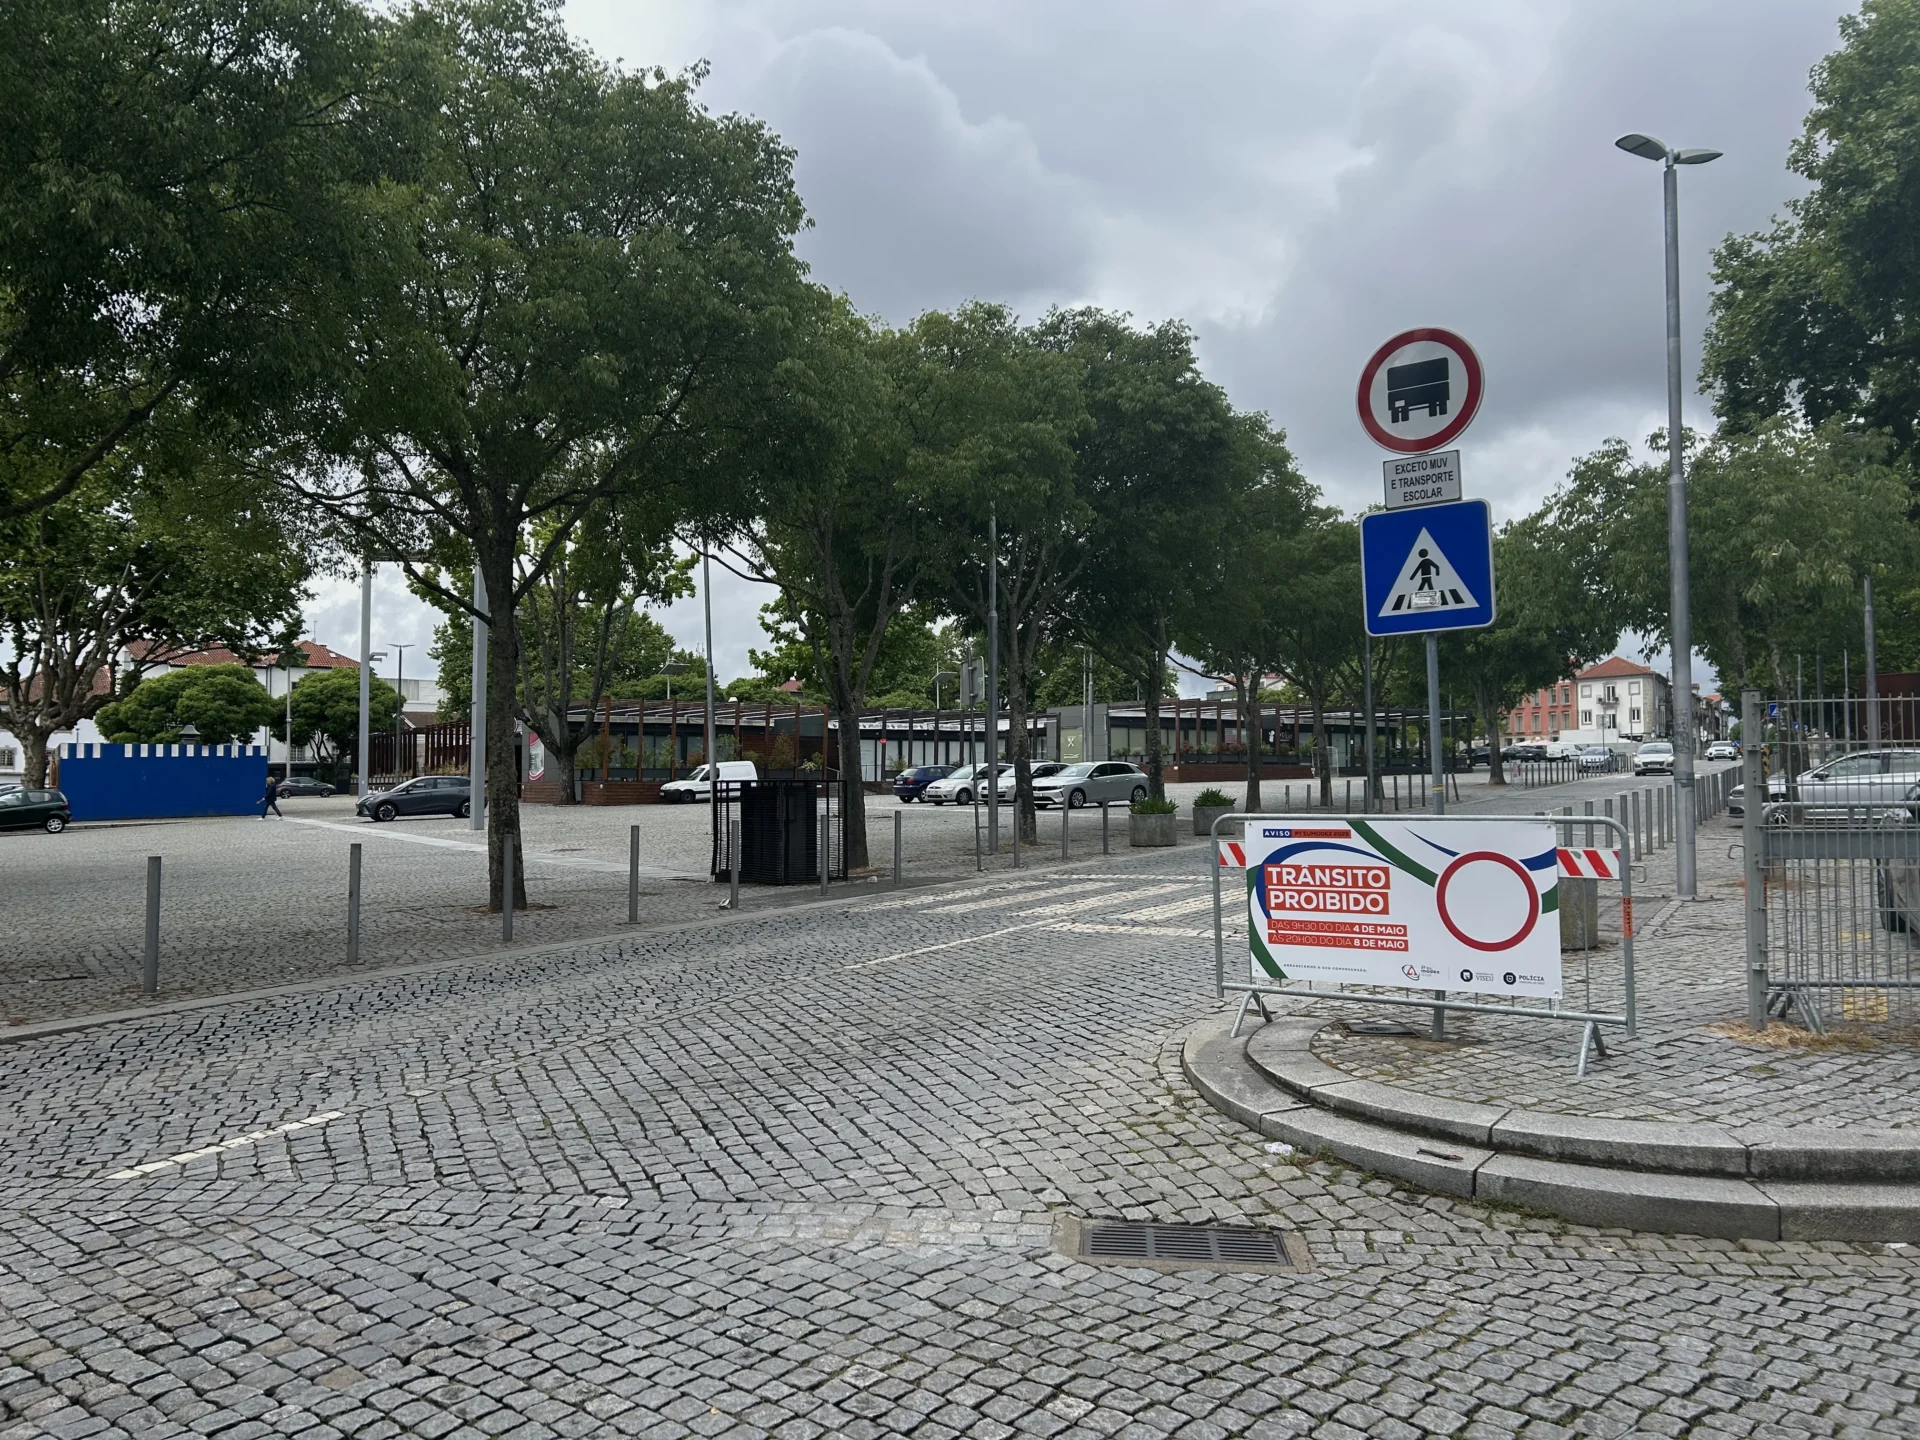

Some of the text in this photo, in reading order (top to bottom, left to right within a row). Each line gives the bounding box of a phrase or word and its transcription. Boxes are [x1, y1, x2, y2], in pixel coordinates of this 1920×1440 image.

[1395, 457, 1448, 475] EXCETO MUV
[1391, 471, 1454, 489] E TRANSPORTE
[1403, 487, 1443, 502] ESCOLAR
[1267, 865, 1386, 888] TRÂNSITO
[1270, 891, 1384, 912] PROIBIDO
[1271, 921, 1290, 930] DAS
[1292, 922, 1317, 931] 9H30
[1319, 923, 1333, 931] DO
[1336, 924, 1351, 932] DIA
[1362, 925, 1375, 933] DE
[1377, 926, 1404, 934] MAIO
[1287, 935, 1318, 944] 20H00
[1320, 936, 1334, 945] DO
[1336, 937, 1352, 946] DIA
[1353, 938, 1360, 946] 8
[1362, 939, 1376, 947] DE
[1378, 940, 1405, 948] MAIO
[1518, 974, 1545, 982] POLÍCIA
